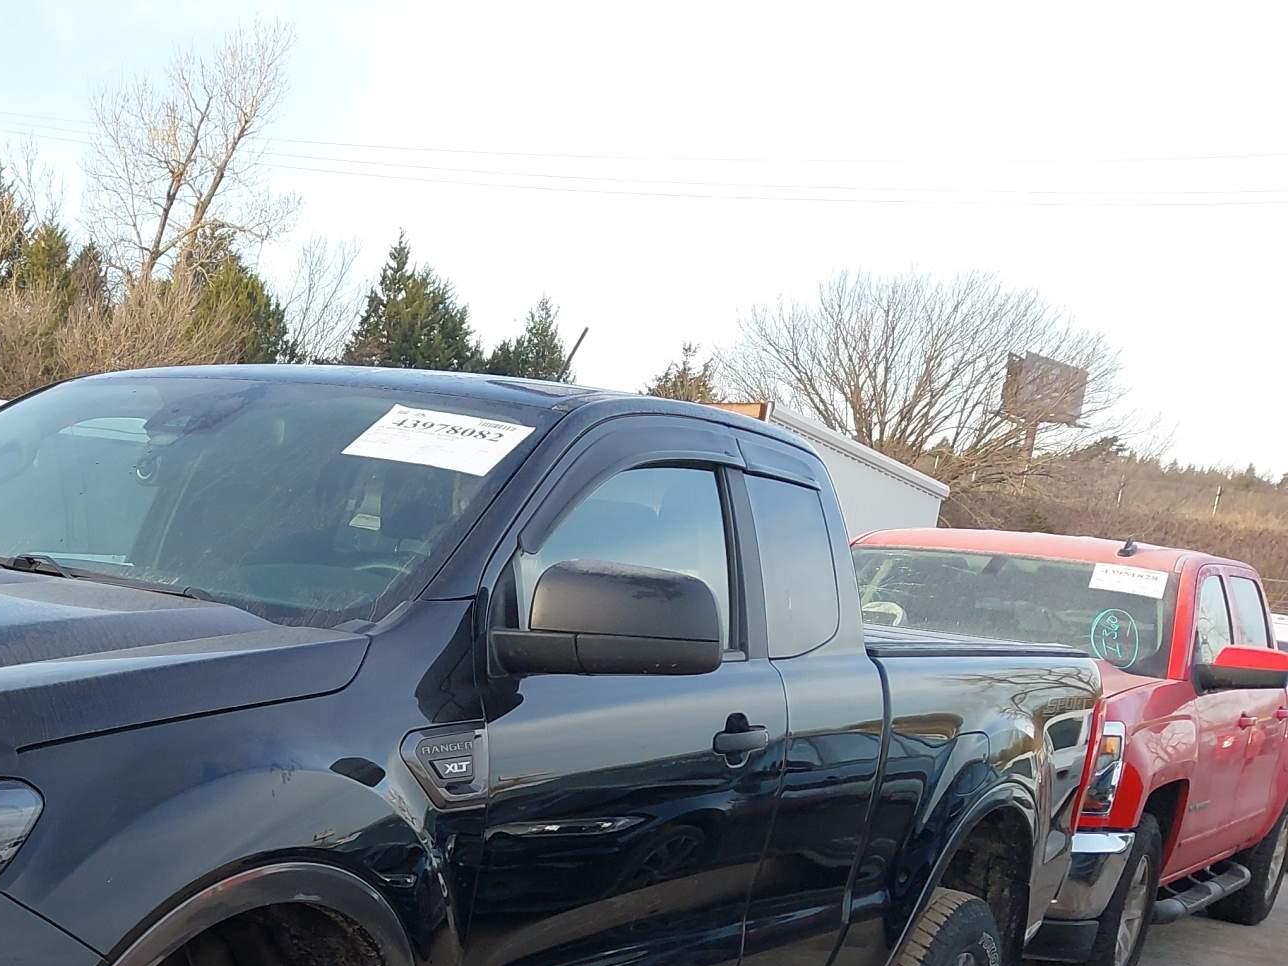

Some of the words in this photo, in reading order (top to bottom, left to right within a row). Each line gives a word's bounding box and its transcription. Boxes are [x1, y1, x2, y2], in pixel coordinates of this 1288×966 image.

[391, 417, 506, 443] 43978082
[421, 741, 473, 755] RANGER
[443, 761, 471, 775] XLT
